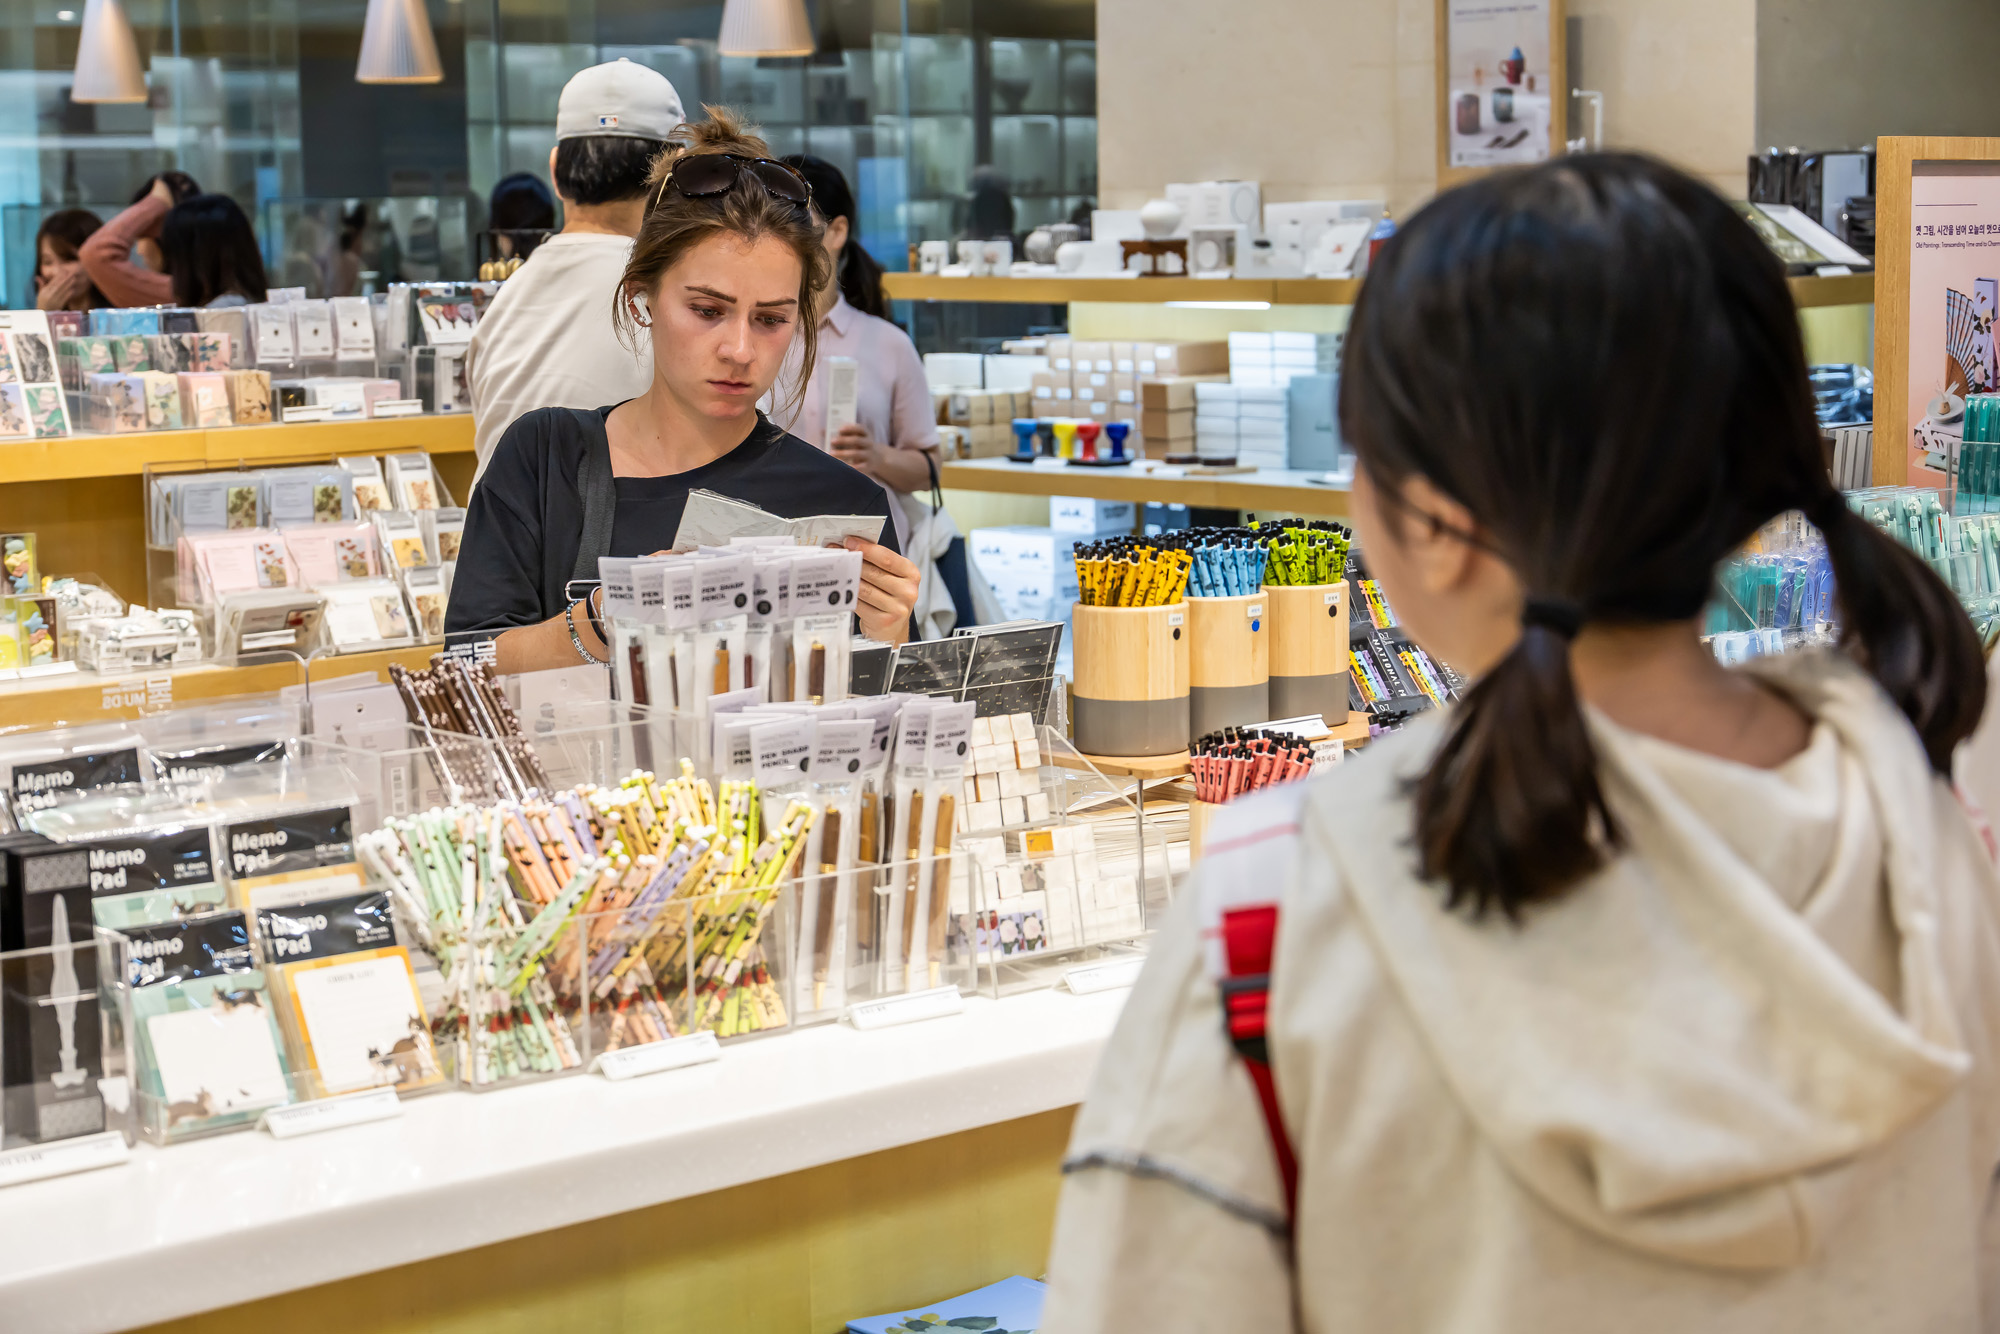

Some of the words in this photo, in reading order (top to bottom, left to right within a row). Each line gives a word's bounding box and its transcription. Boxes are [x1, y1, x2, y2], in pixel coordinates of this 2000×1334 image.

[1923, 225, 1935, 236] 그림,
[1937, 225, 1954, 236] 시간을
[1956, 224, 1966, 236] 넘어
[1968, 224, 1985, 235] 오늘의
[1372, 638, 1401, 686] NATIONAL
[18, 770, 74, 792] Memo
[232, 830, 288, 852] Memo
[89, 848, 146, 870] Memo
[233, 848, 270, 872] Pad
[90, 867, 127, 892] Pad
[127, 937, 184, 960] Memo
[275, 933, 312, 958] Pad
[128, 957, 165, 981] Pad
